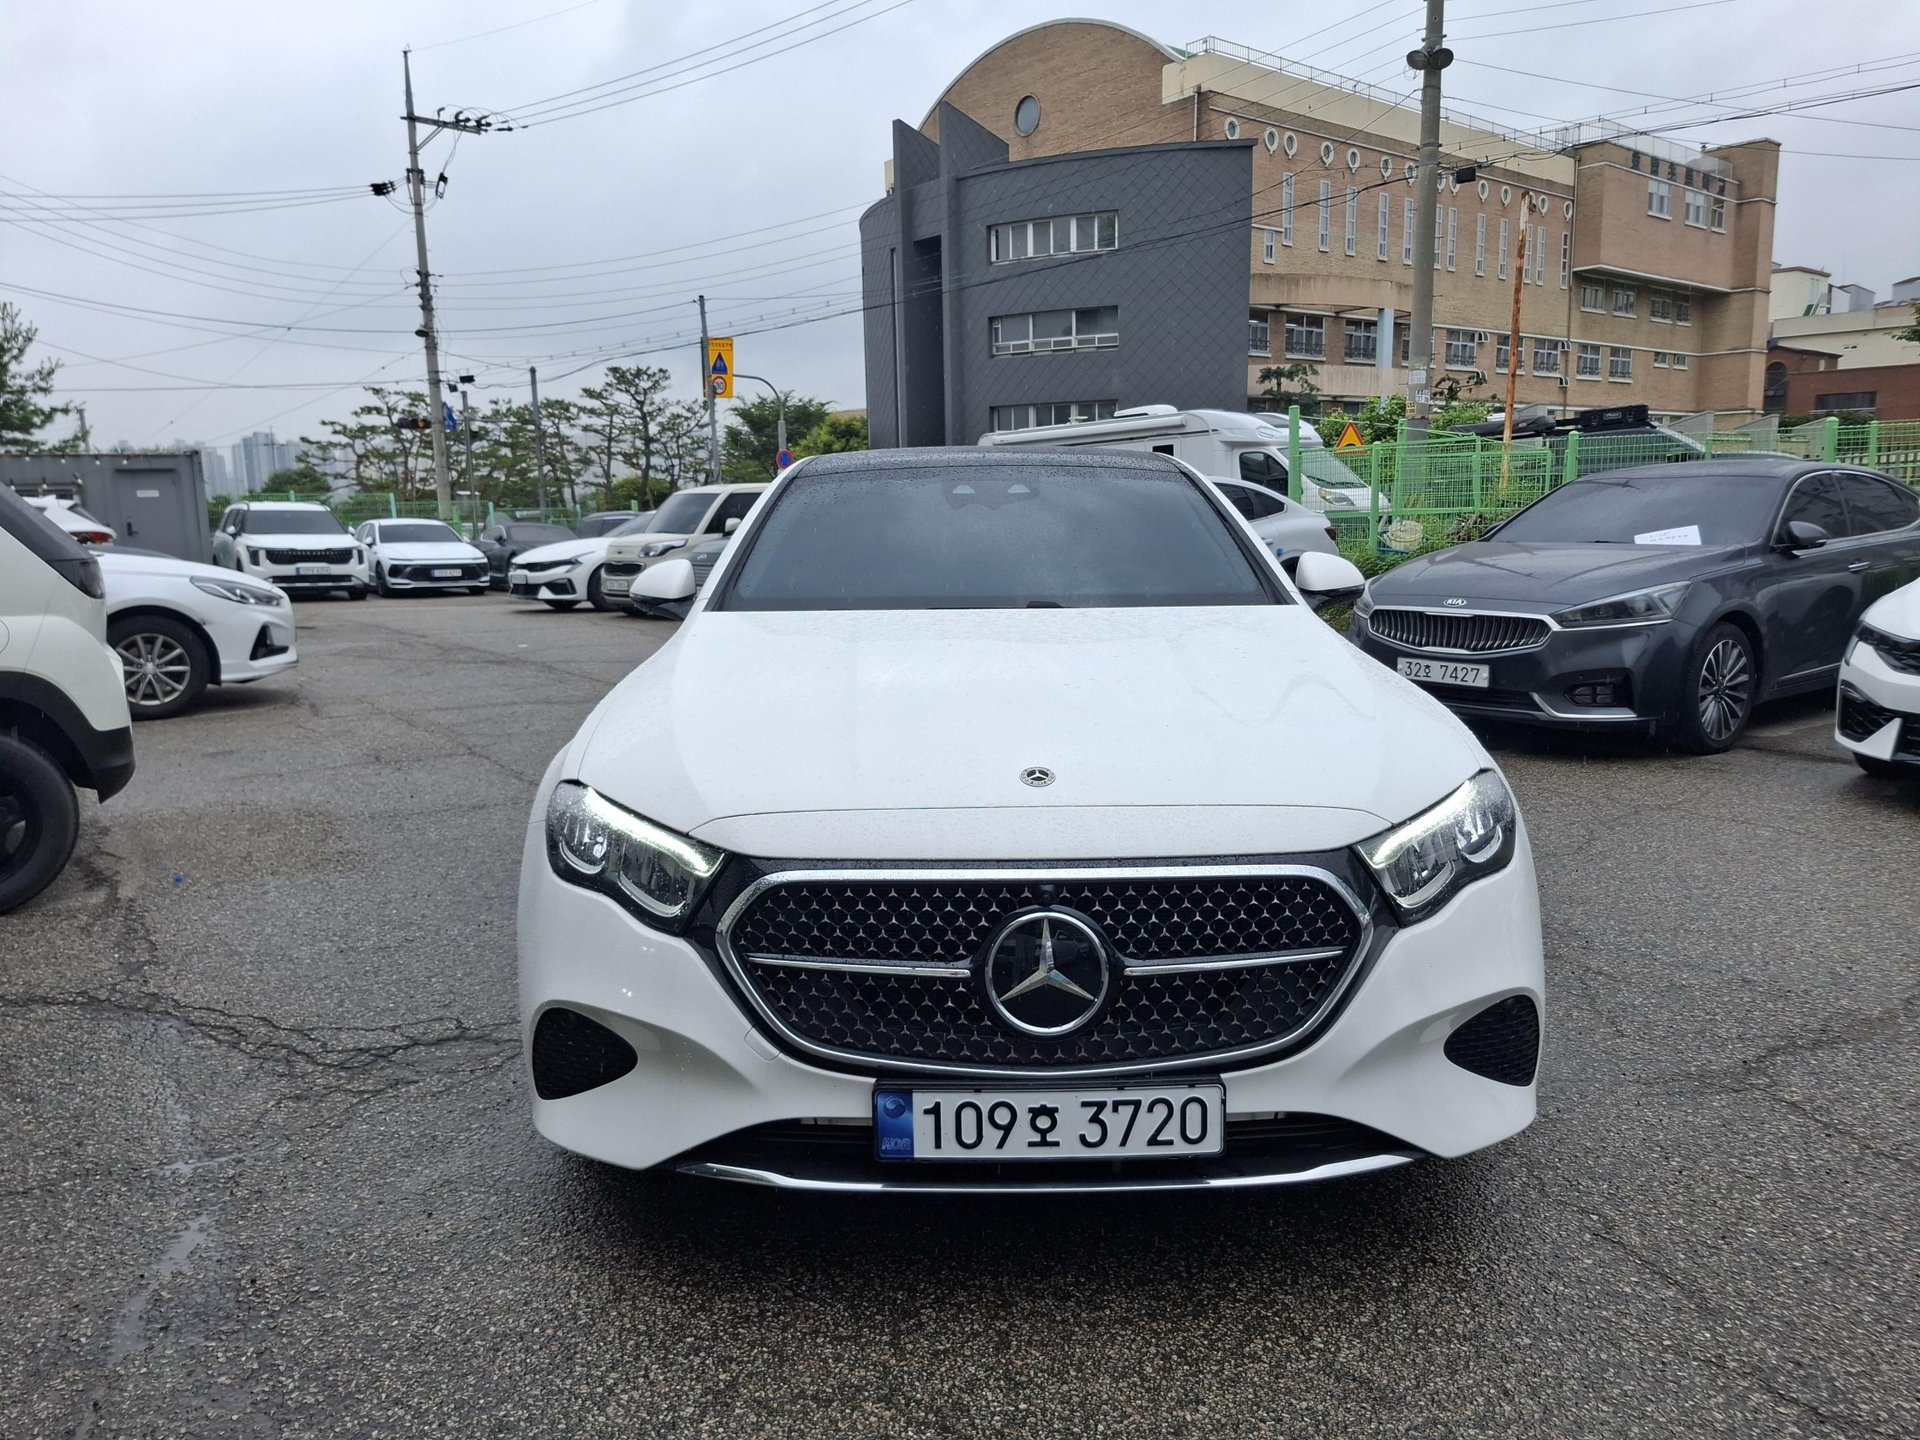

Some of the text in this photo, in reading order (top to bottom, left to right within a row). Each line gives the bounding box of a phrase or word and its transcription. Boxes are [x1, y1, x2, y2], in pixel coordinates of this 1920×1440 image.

[1404, 661, 1480, 683] 32호 7427
[923, 1095, 1208, 1150] 109호 3720
[881, 1137, 911, 1151] KOR
